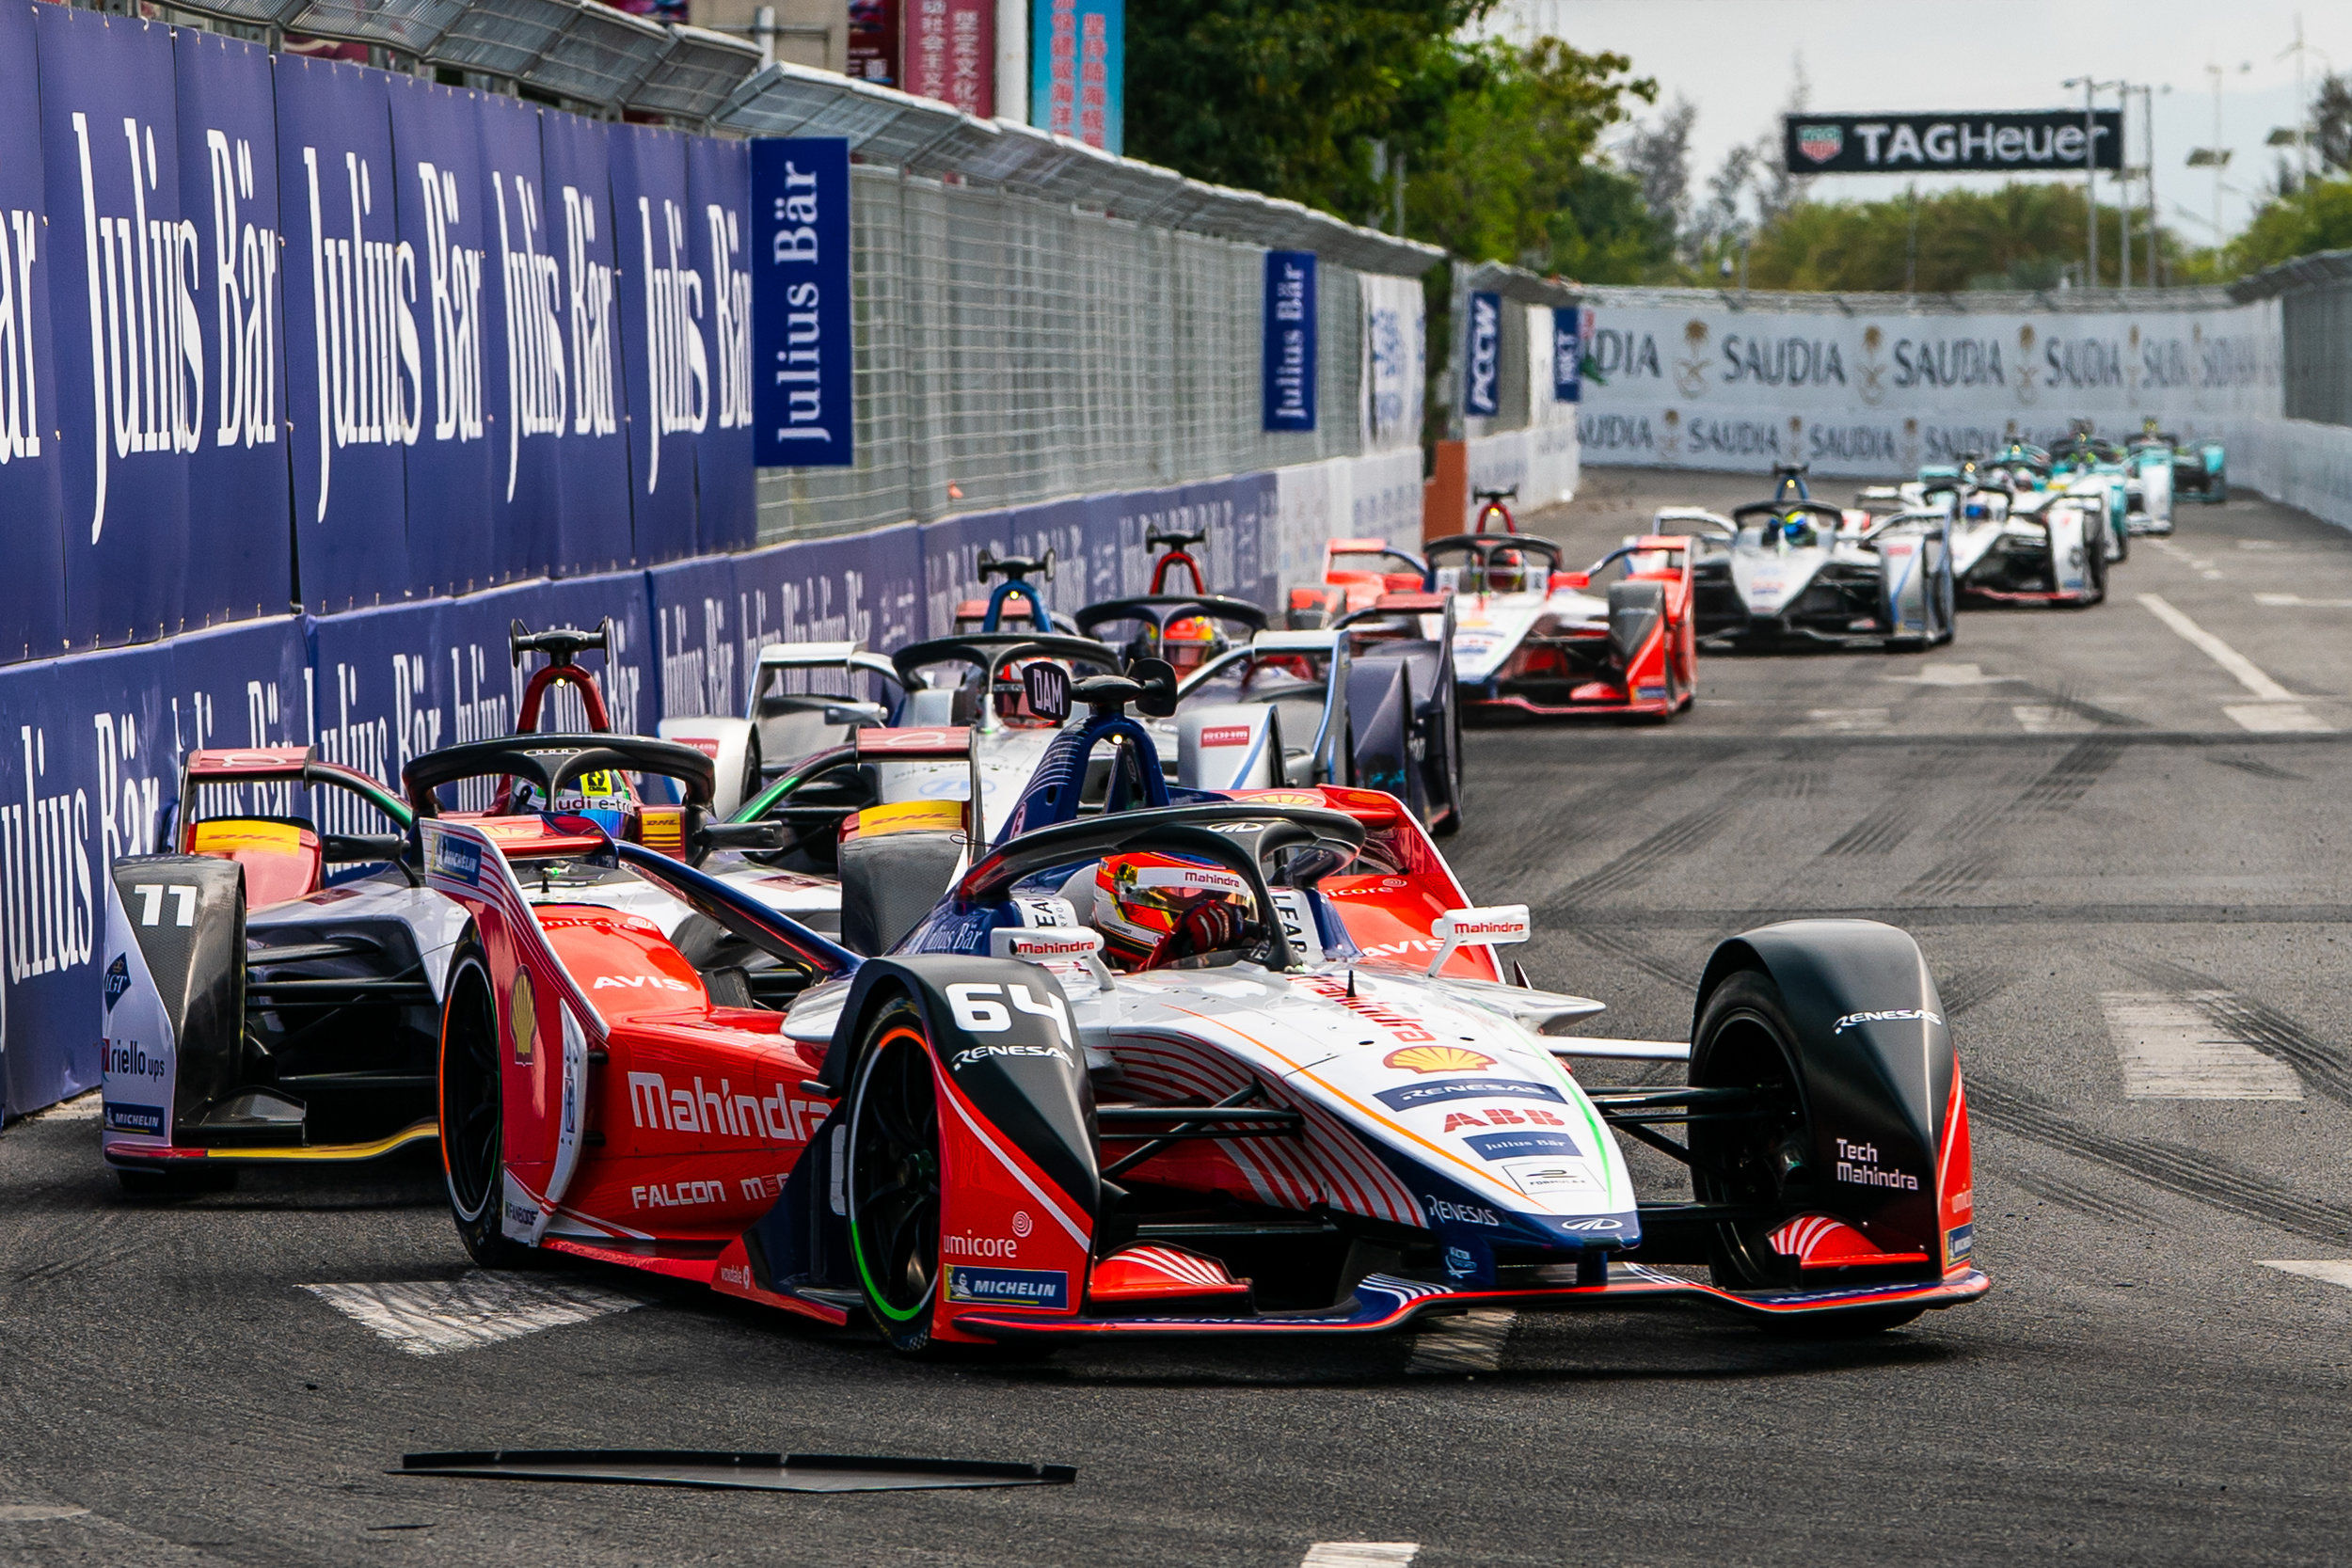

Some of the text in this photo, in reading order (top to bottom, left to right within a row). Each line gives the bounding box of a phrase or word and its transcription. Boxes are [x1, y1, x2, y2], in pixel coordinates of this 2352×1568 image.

[773, 161, 832, 443] Julius Bär
[72, 112, 276, 545] Julius Bär
[303, 147, 483, 524] Julius Bär
[492, 170, 617, 503] Julius Bär
[639, 196, 709, 496] Julius
[1276, 262, 1308, 420] Julius Bär
[1586, 329, 1662, 378] DIA
[1721, 333, 1847, 388] SAUDIA
[1894, 337, 2006, 388] SAUDIA
[1577, 414, 1653, 450] AUDIA
[1688, 417, 1782, 454] SAUDIA
[1033, 668, 1063, 716] DAM
[555, 797, 592, 810] udi
[0, 725, 92, 1052] ulius
[1184, 871, 1240, 888] Mahindra
[135, 884, 198, 927] 11
[1273, 895, 1308, 953] LEAR
[1454, 921, 1524, 934] Mahindra
[1017, 941, 1095, 955] Mahindra
[593, 975, 689, 991] AVIS
[946, 983, 1073, 1050] 64
[1832, 1009, 1943, 1036] RENESAS
[111, 1039, 166, 1083] riello ups
[628, 1070, 833, 1142] Mahindra
[1400, 1083, 1546, 1101] RENESAS
[116, 1113, 159, 1127] MICHELIN
[1444, 1108, 1565, 1133] ABB
[1837, 1137, 1878, 1163] Tech
[631, 1180, 726, 1209] FALCON
[1837, 1162, 1918, 1191] Mahindra
[1424, 1194, 1500, 1227] RENESAS
[944, 1228, 1017, 1259] umicore
[974, 1280, 1056, 1297] MICHELIN
